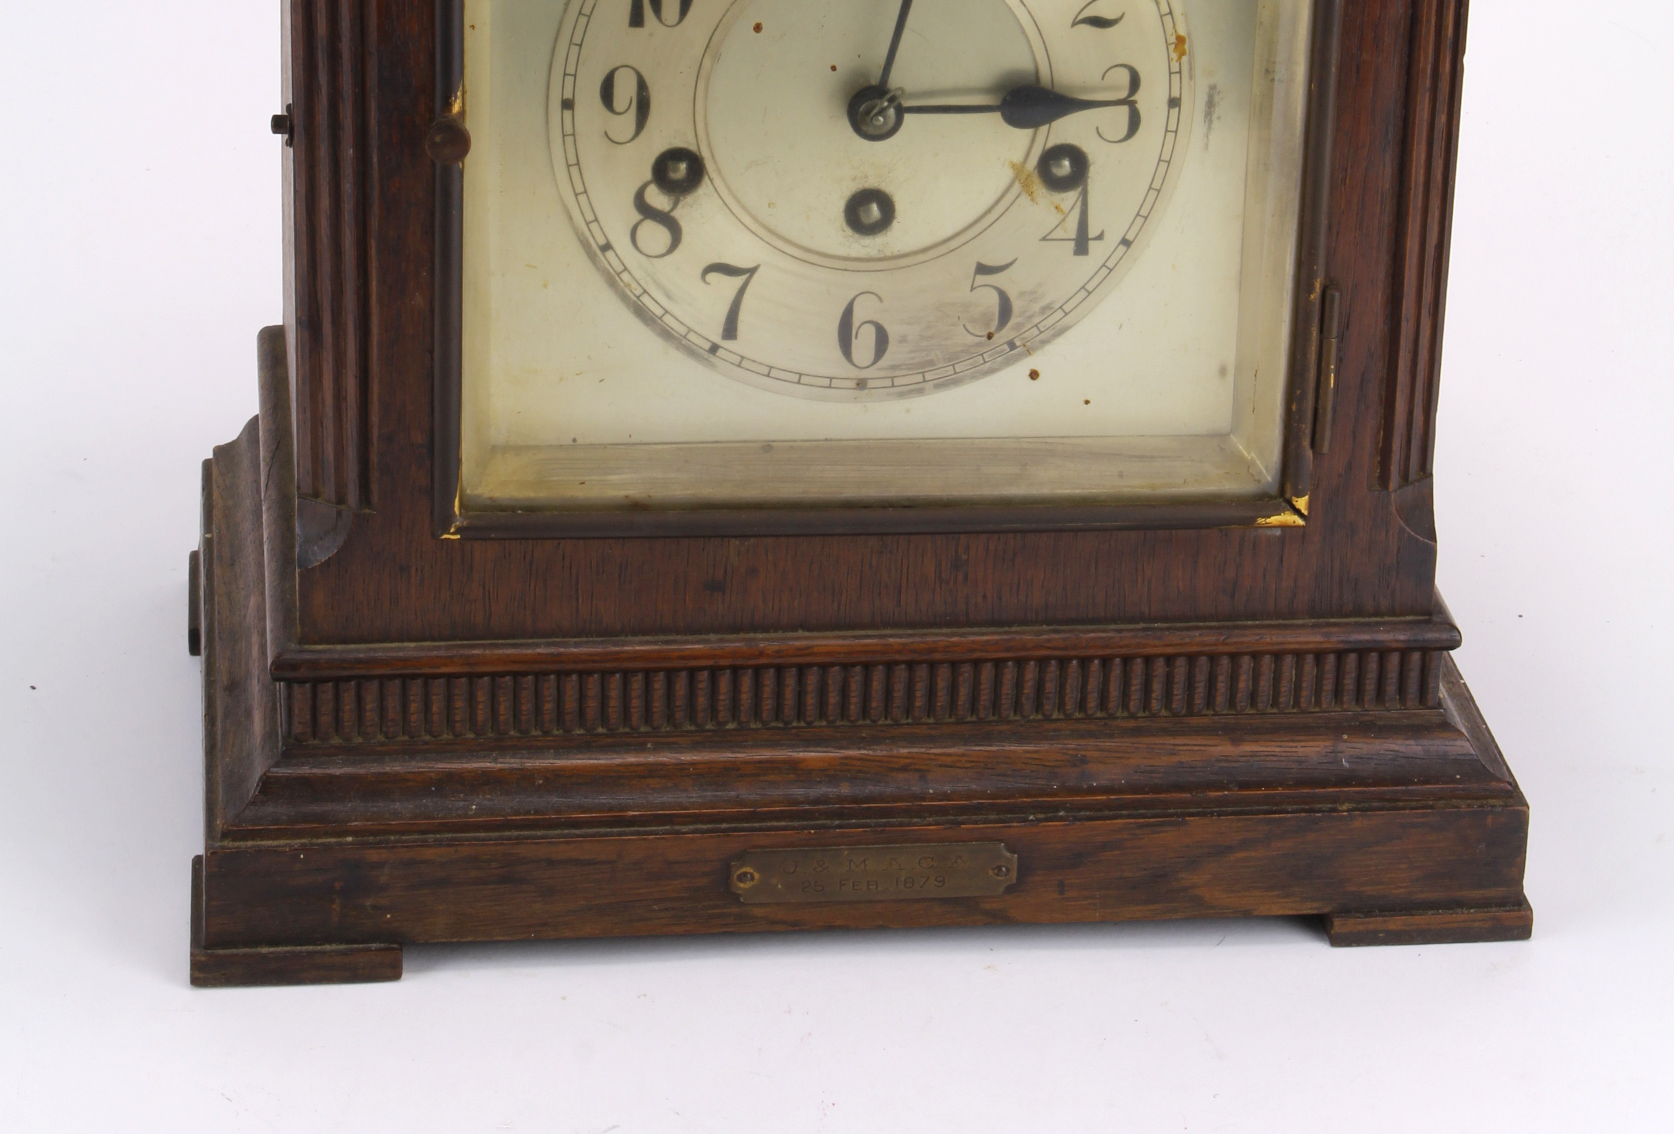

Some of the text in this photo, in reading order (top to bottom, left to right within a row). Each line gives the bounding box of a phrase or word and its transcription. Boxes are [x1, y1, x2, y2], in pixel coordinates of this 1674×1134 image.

[599, 64, 651, 146] 9
[1095, 63, 1142, 144] 3
[629, 175, 683, 259] 8
[1038, 174, 1105, 257] 4
[700, 262, 762, 341] 7
[837, 291, 890, 369] 6
[961, 257, 1019, 338] 5
[895, 874, 946, 889] 1879
